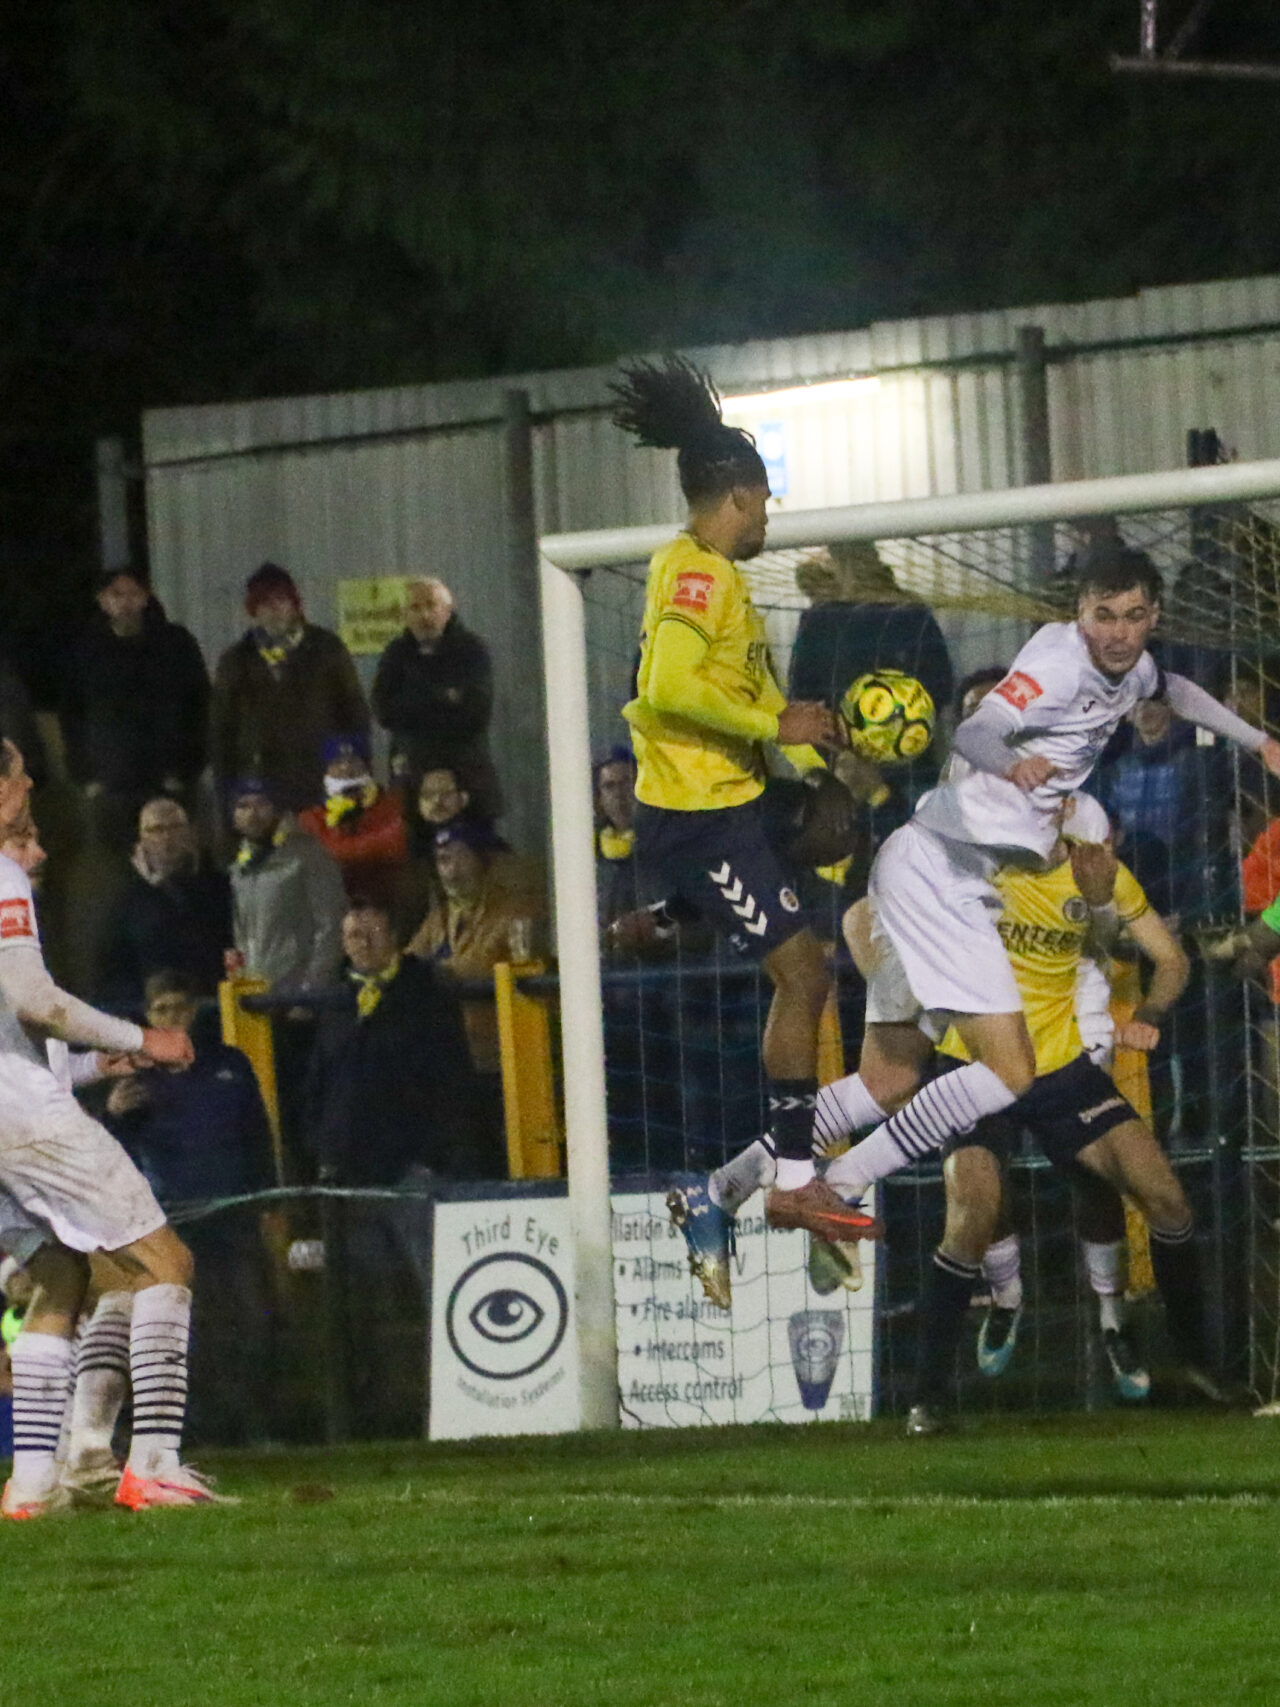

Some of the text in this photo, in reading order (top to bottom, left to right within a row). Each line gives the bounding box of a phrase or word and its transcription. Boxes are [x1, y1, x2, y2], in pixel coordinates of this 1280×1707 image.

[460, 1214, 561, 1256] Third Eye
[632, 1256, 683, 1281] Alarms
[643, 1297, 670, 1321] Fire
[647, 1337, 725, 1361] Intercoms
[629, 1372, 744, 1403] Access control
